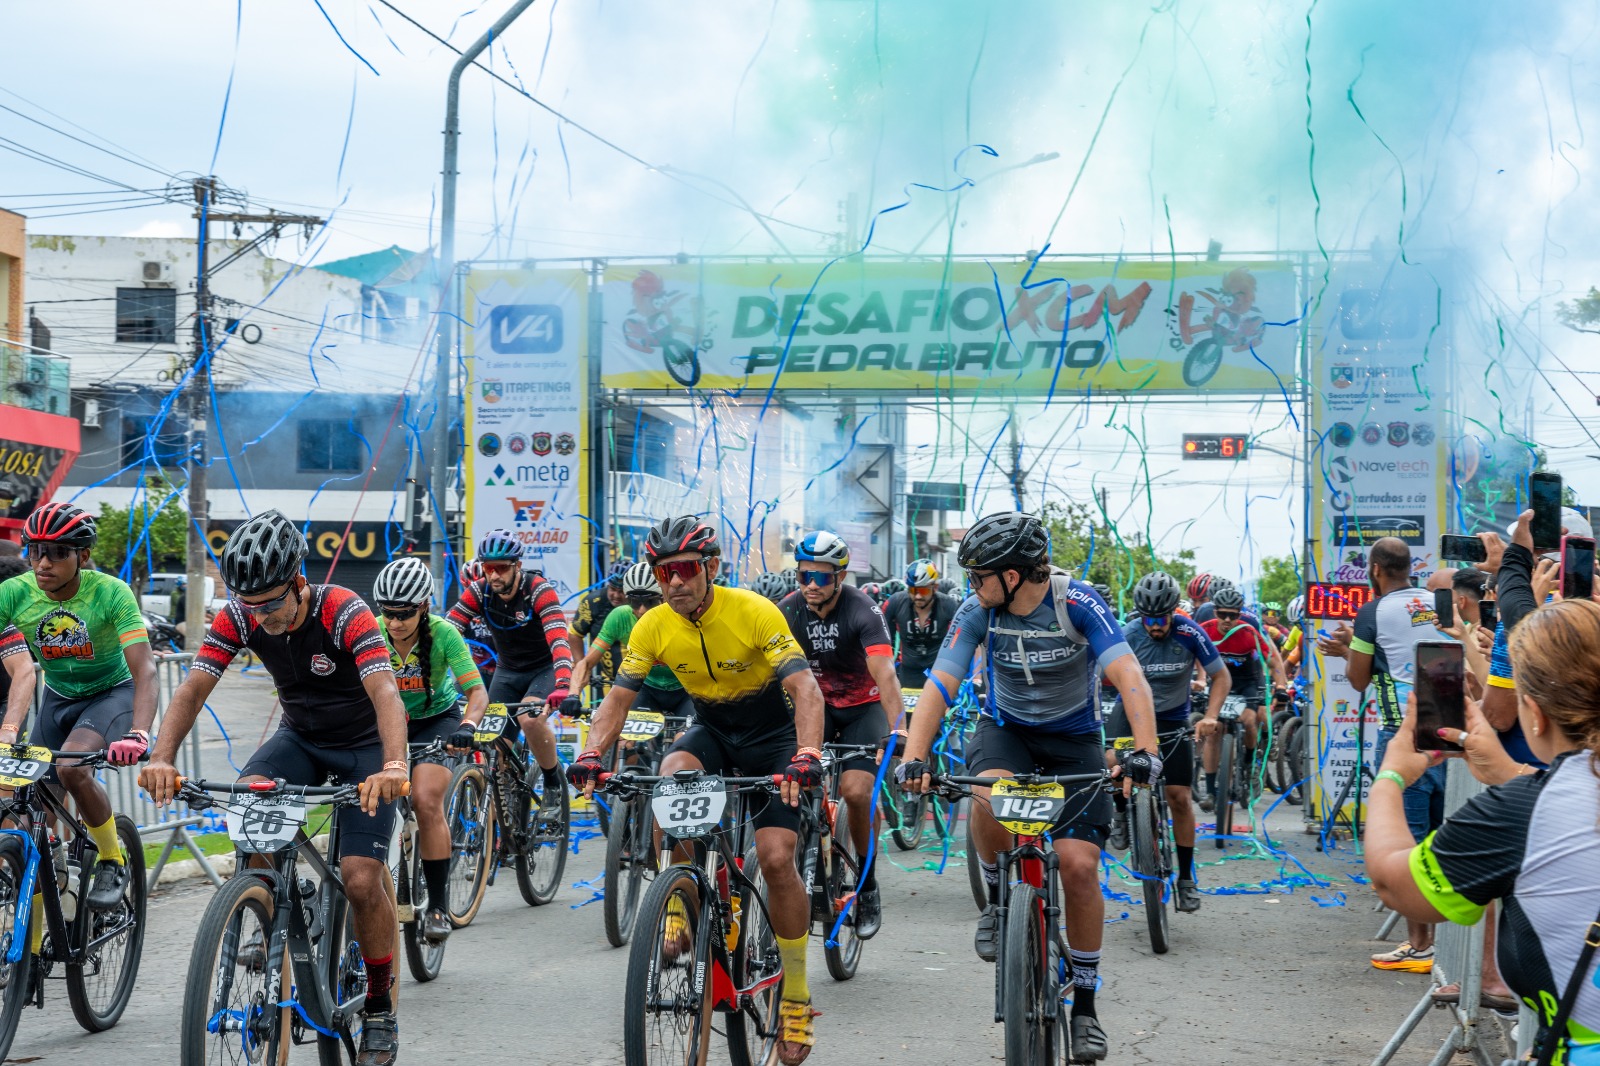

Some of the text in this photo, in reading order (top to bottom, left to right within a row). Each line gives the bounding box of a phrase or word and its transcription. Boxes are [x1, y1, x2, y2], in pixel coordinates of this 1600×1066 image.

[732, 281, 1152, 338] DESAFIO XCM
[500, 314, 553, 344] V4
[1356, 367, 1427, 378] ITAPETINA
[505, 382, 571, 393] ITAPETINGA
[1221, 437, 1244, 456] 61
[517, 462, 570, 481] meta
[1359, 460, 1430, 472] Navetech
[1414, 492, 1427, 503] cia
[1010, 643, 1078, 663] BREAK
[476, 716, 504, 732] 03
[622, 720, 662, 734] 205
[0, 757, 40, 777] 39
[1330, 759, 1371, 767] FAZENA
[660, 780, 718, 792] DESAFIO XCM
[669, 796, 712, 821] 33
[1000, 798, 1053, 820] 142
[238, 810, 287, 835] 26
[694, 961, 706, 994] ROCKSHOX
